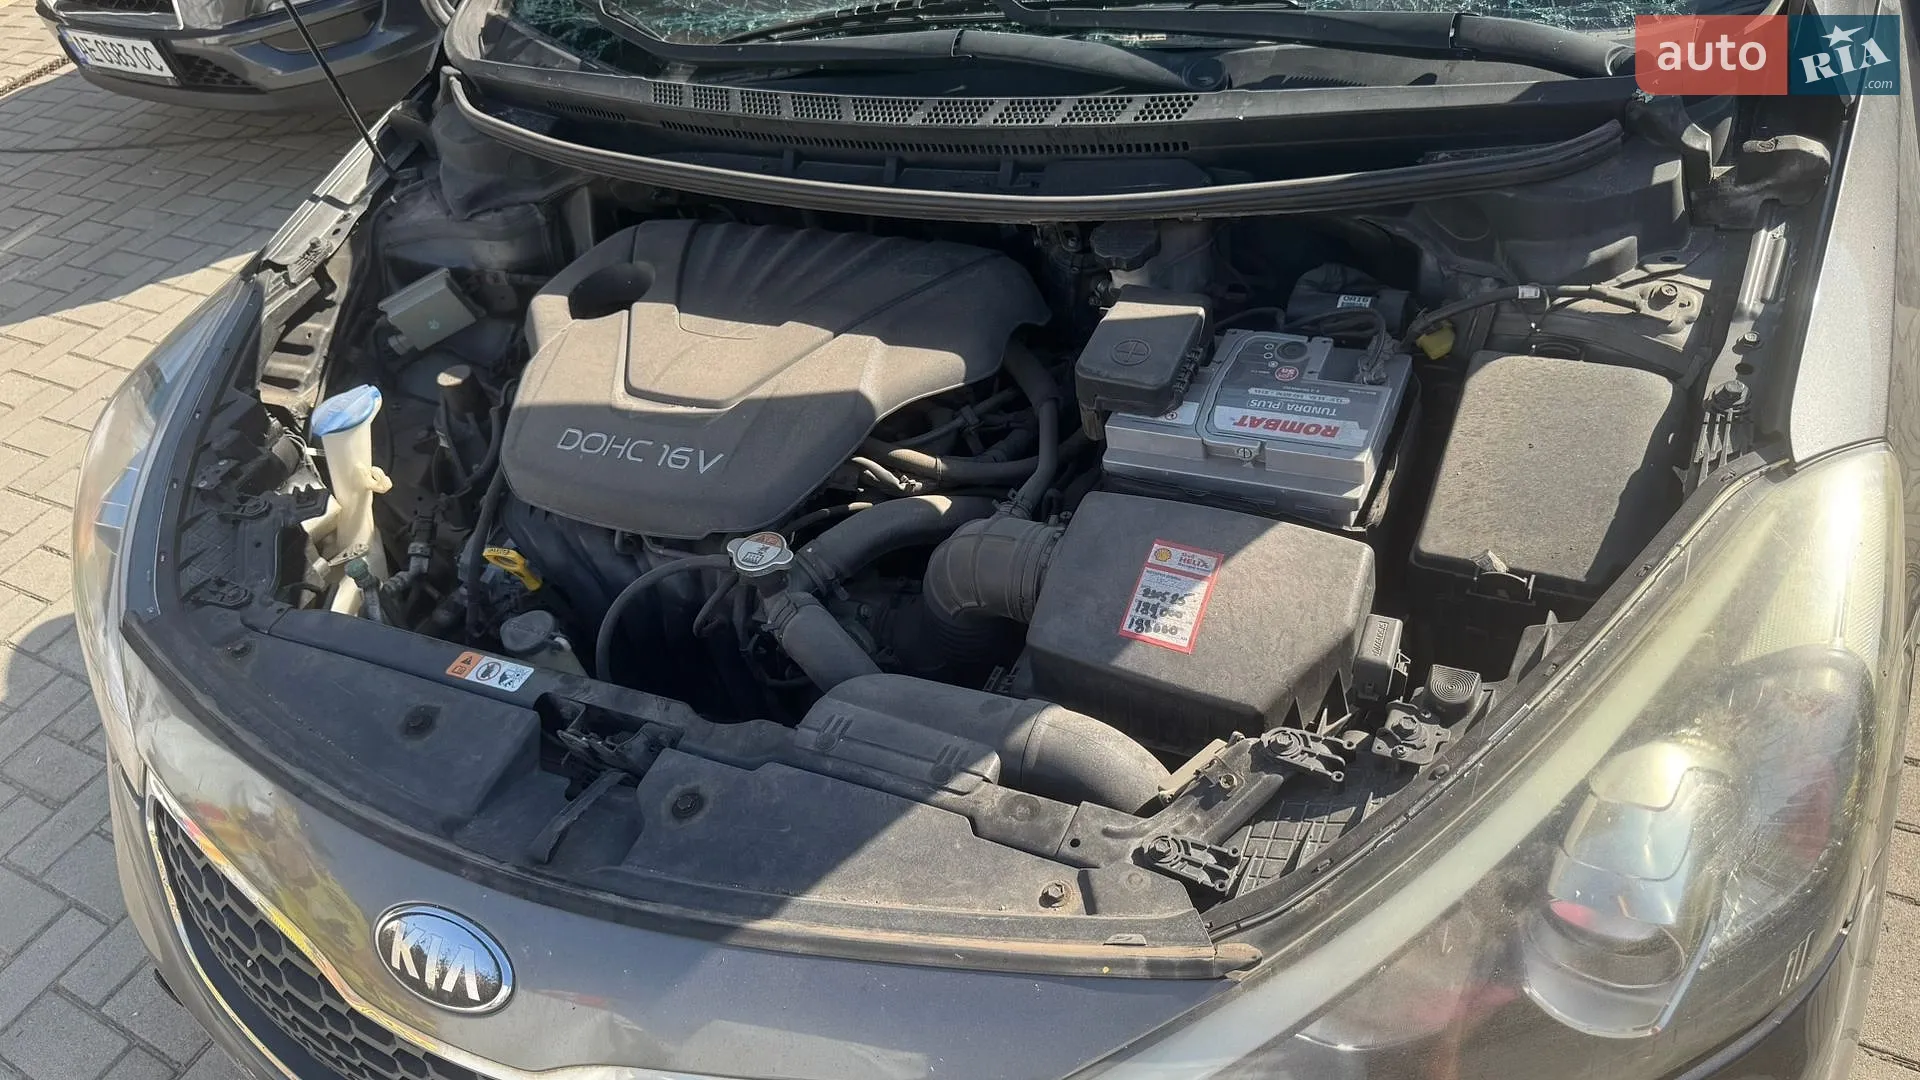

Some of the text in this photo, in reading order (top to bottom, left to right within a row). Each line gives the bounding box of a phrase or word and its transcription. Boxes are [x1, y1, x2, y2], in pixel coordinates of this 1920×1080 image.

[1233, 414, 1341, 438] ROMBAT
[1286, 402, 1337, 417] TUNDRA
[557, 427, 725, 475] DOHC 16V
[391, 918, 481, 1002] KIA
